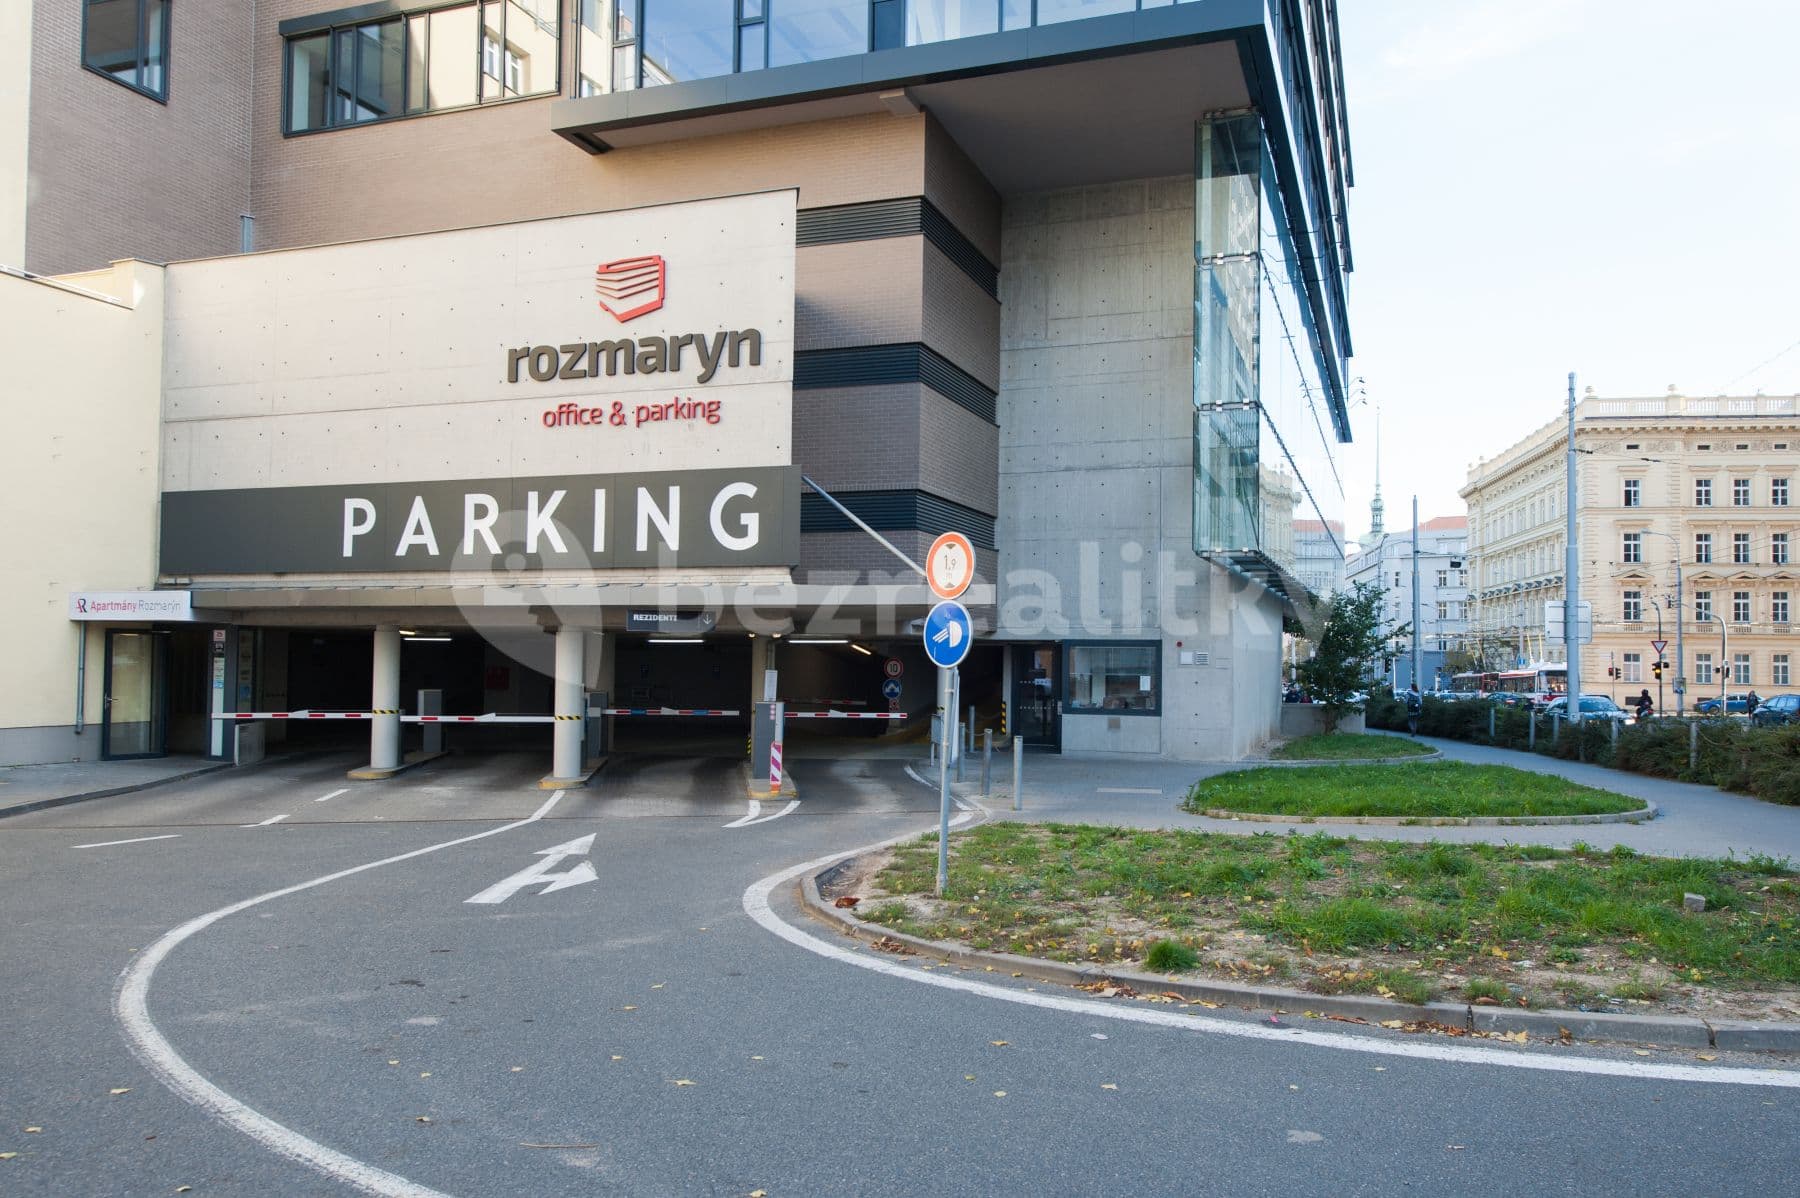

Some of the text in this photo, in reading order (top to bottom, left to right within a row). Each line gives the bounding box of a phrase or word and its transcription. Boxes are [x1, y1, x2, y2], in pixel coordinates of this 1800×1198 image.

[507, 327, 761, 384] rozmaryn
[542, 396, 721, 427] office & parking
[342, 482, 760, 557] PARKING
[91, 600, 137, 612] Apartmány
[633, 613, 678, 622] REZIDENTI
[890, 664, 898, 672] 10
